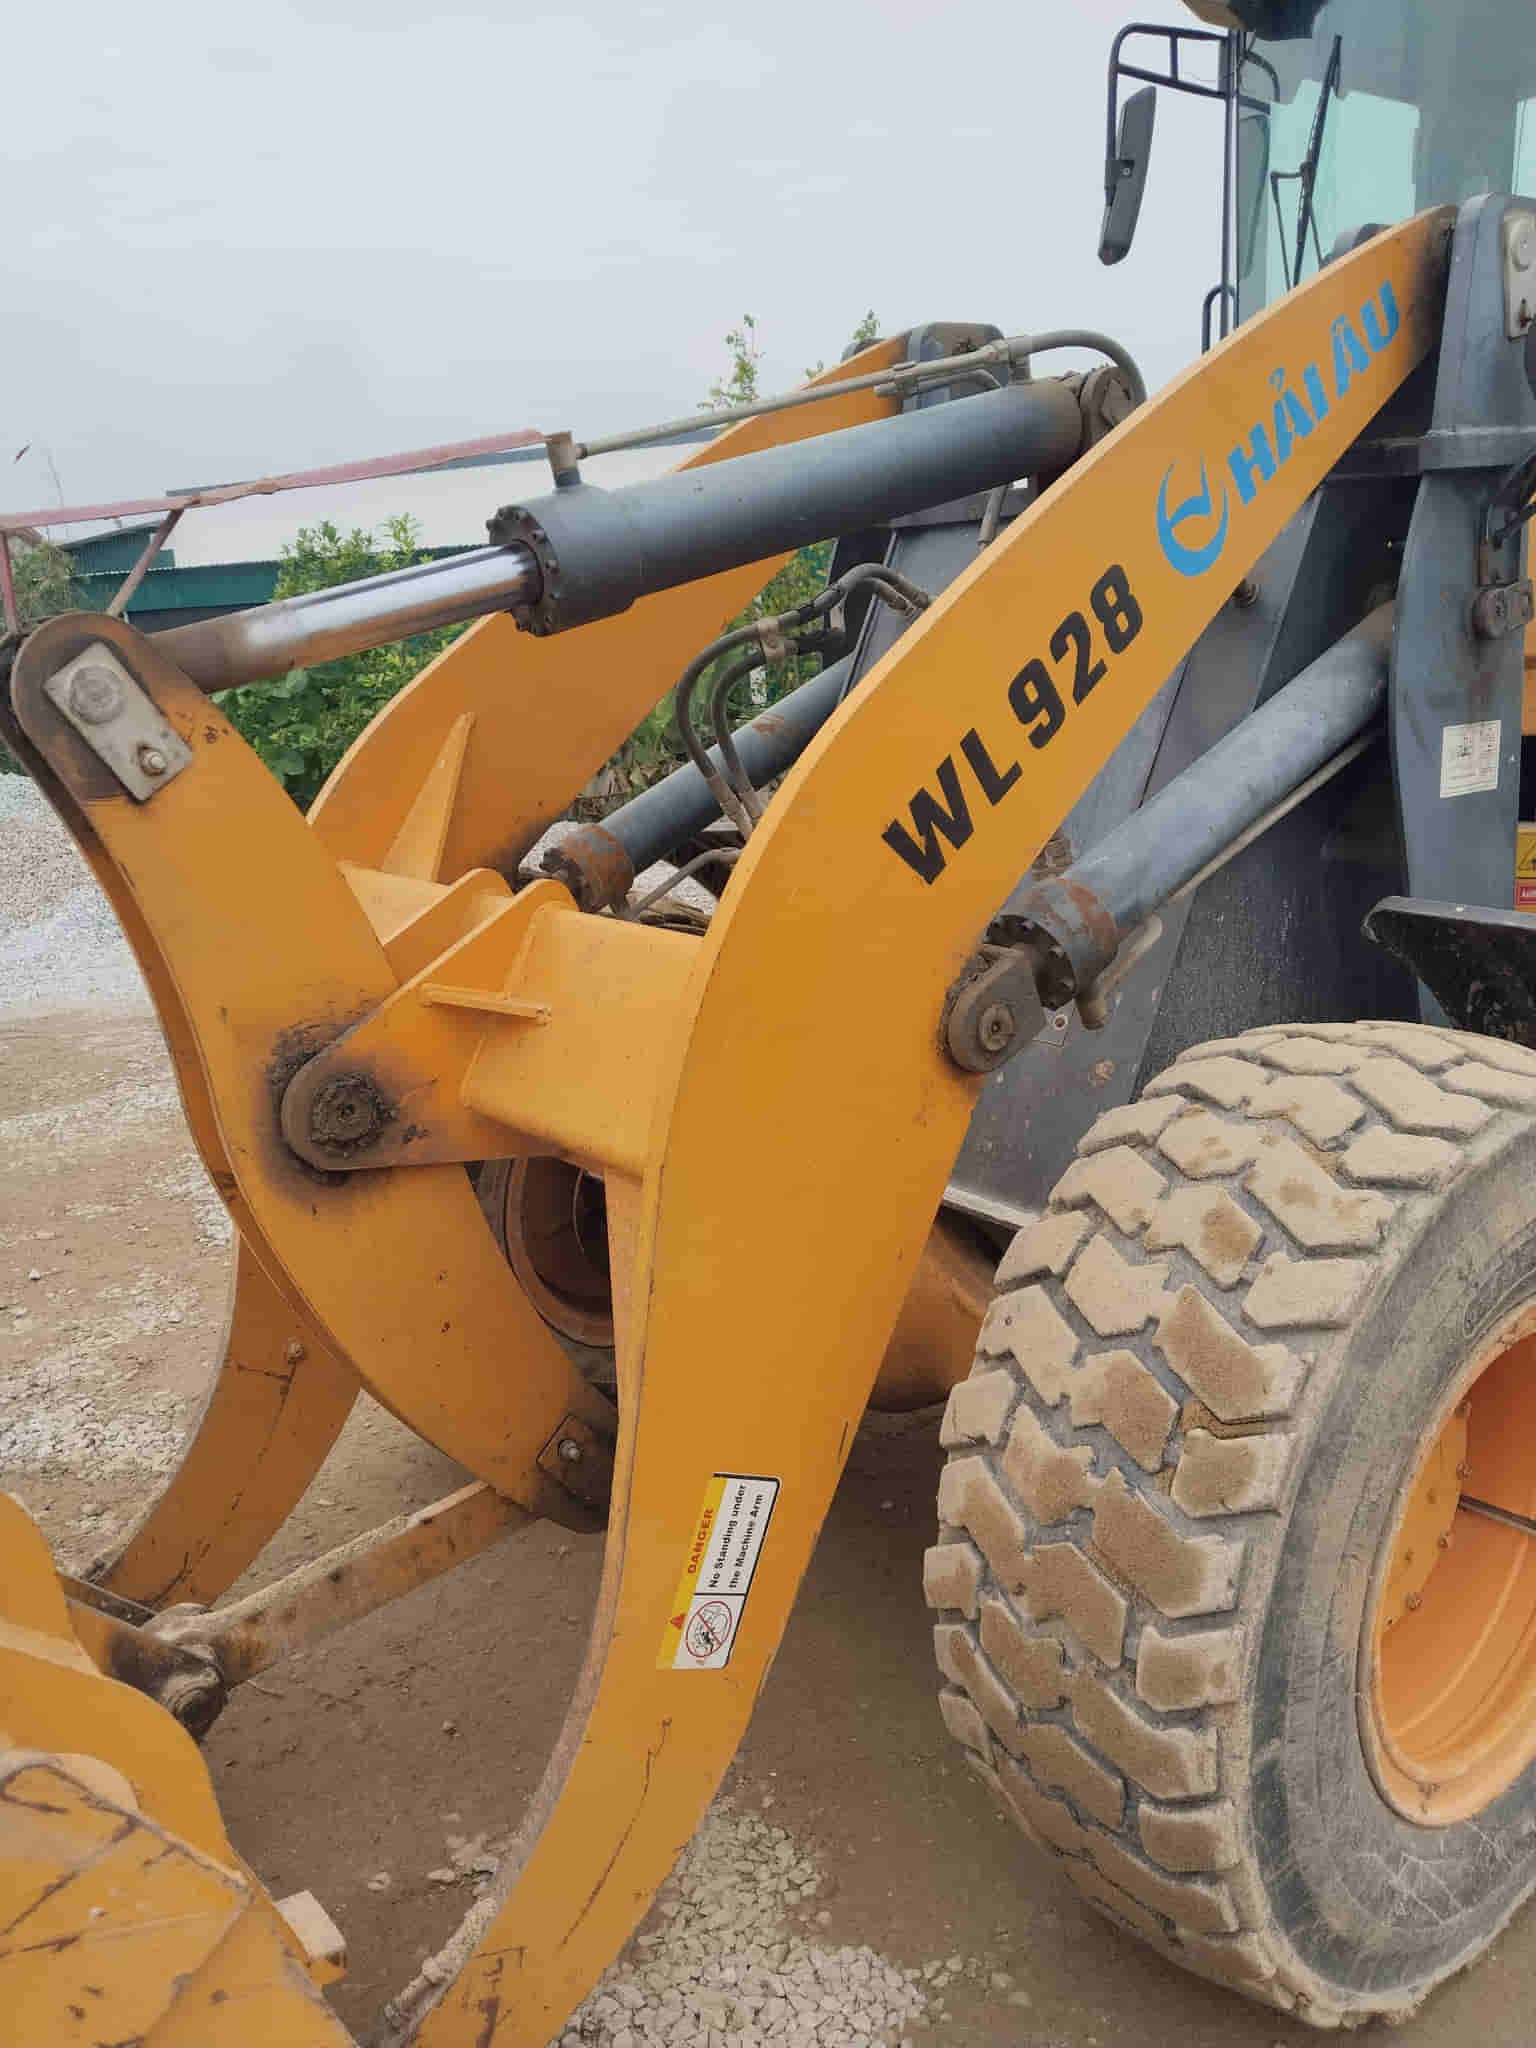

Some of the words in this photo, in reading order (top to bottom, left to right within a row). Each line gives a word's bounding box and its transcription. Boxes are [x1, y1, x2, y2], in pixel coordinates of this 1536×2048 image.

[1227, 367, 1329, 505] HẢI
[1330, 280, 1400, 398] ÂU
[881, 727, 1023, 885] WL
[1008, 563, 1143, 750] 928
[688, 1509, 713, 1574] DANGER
[709, 1571, 720, 1588] No
[715, 1520, 737, 1570] Standing
[732, 1485, 747, 1517] under
[729, 1570, 741, 1588] the
[735, 1521, 755, 1568] Machine
[750, 1493, 764, 1518] Arm
